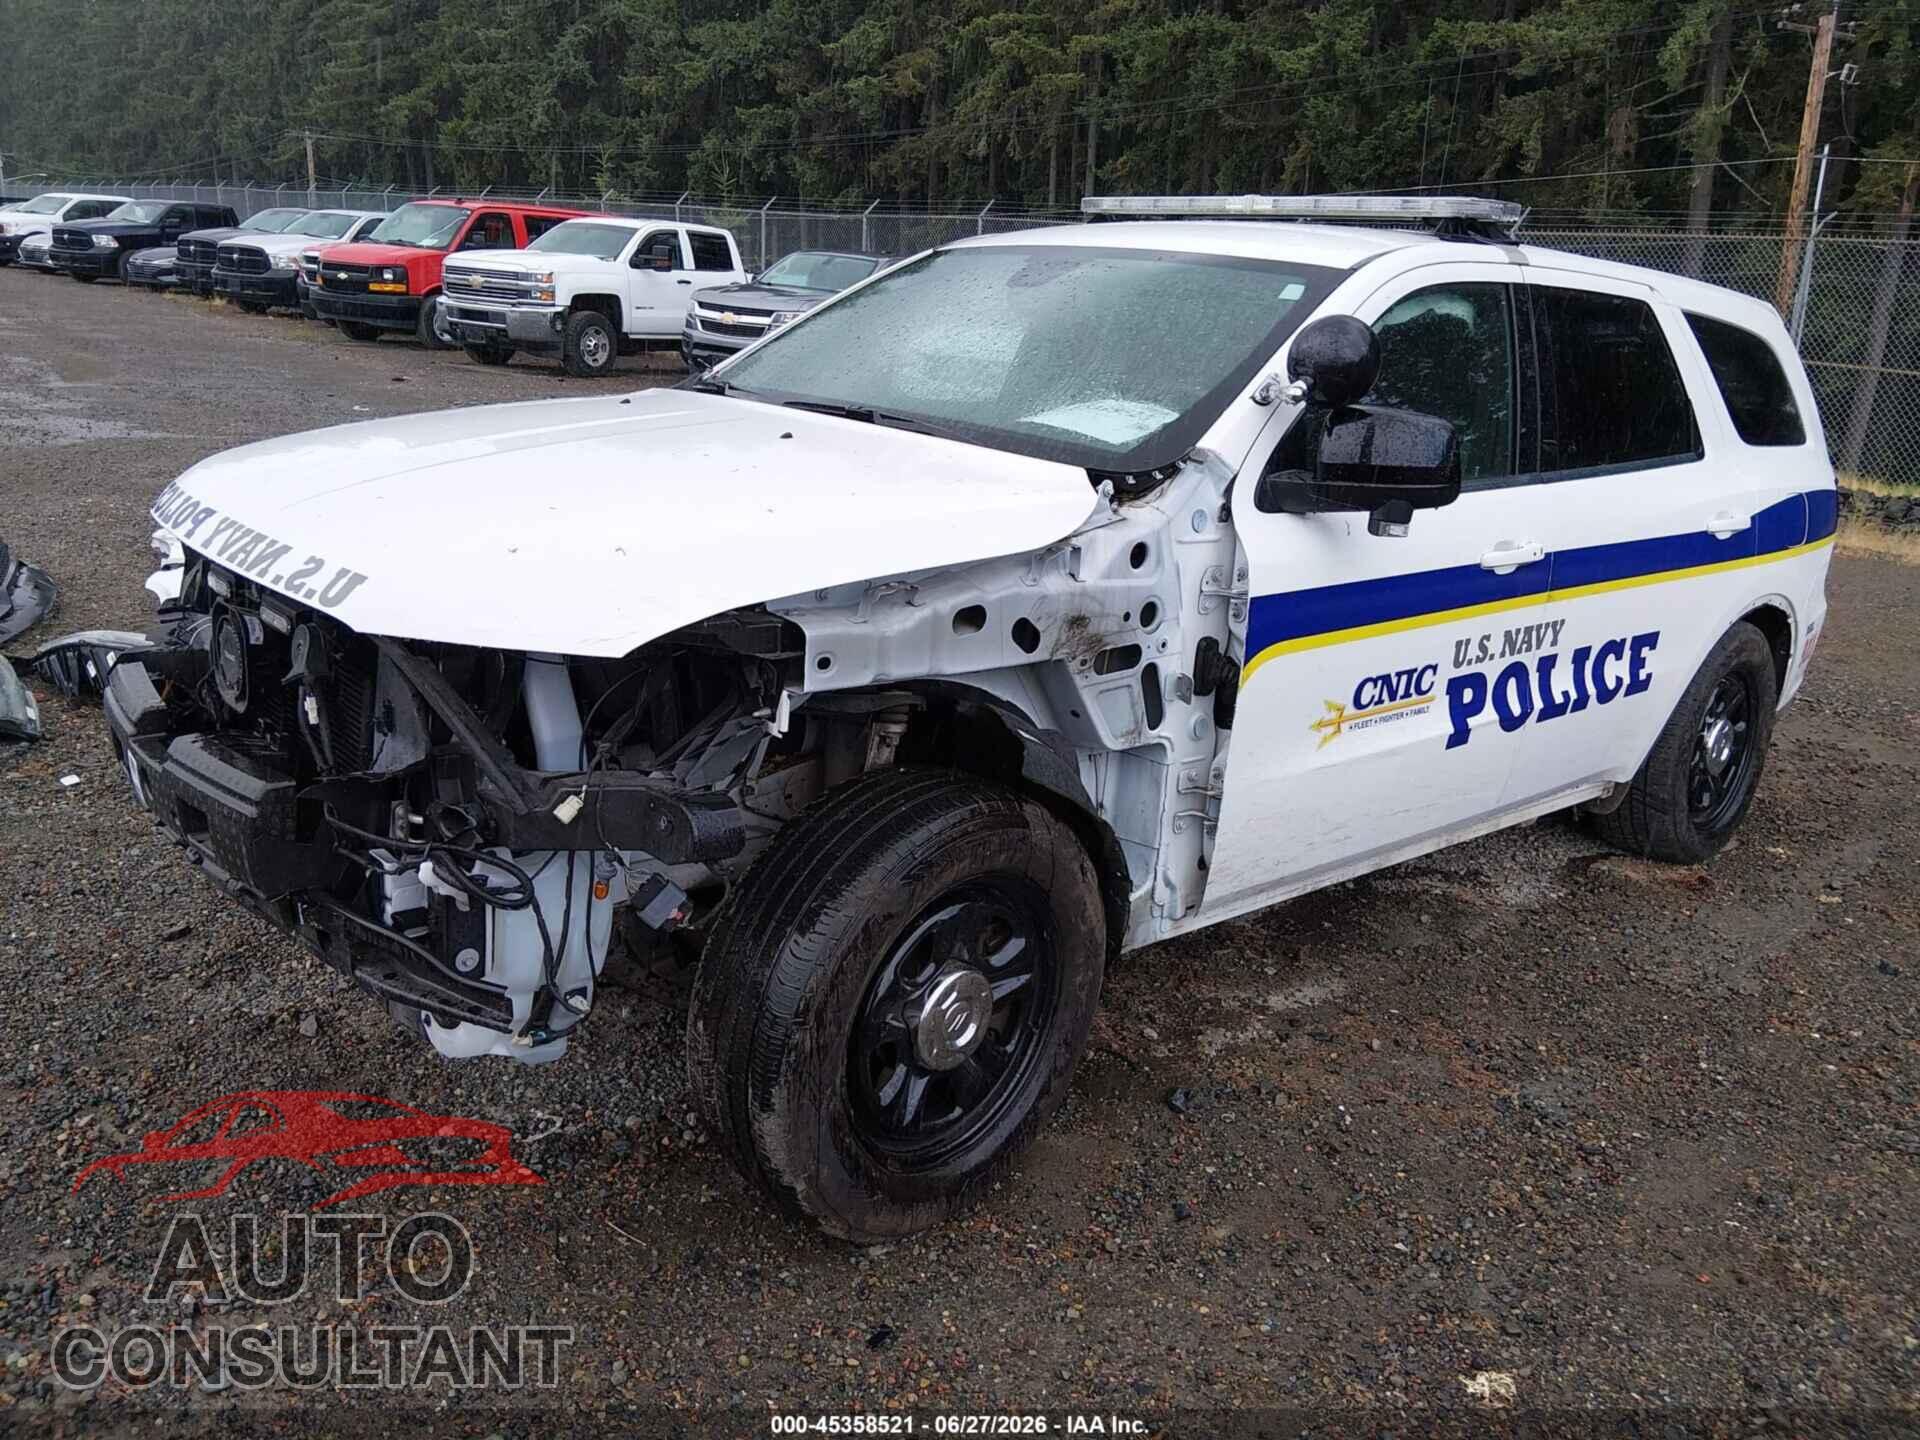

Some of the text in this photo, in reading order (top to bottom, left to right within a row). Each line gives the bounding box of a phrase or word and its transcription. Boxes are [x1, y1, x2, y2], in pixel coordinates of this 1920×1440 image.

[1453, 618, 1566, 669] U.S. NAVY
[1353, 663, 1438, 710] CNIC
[1445, 630, 1661, 750] POLICE
